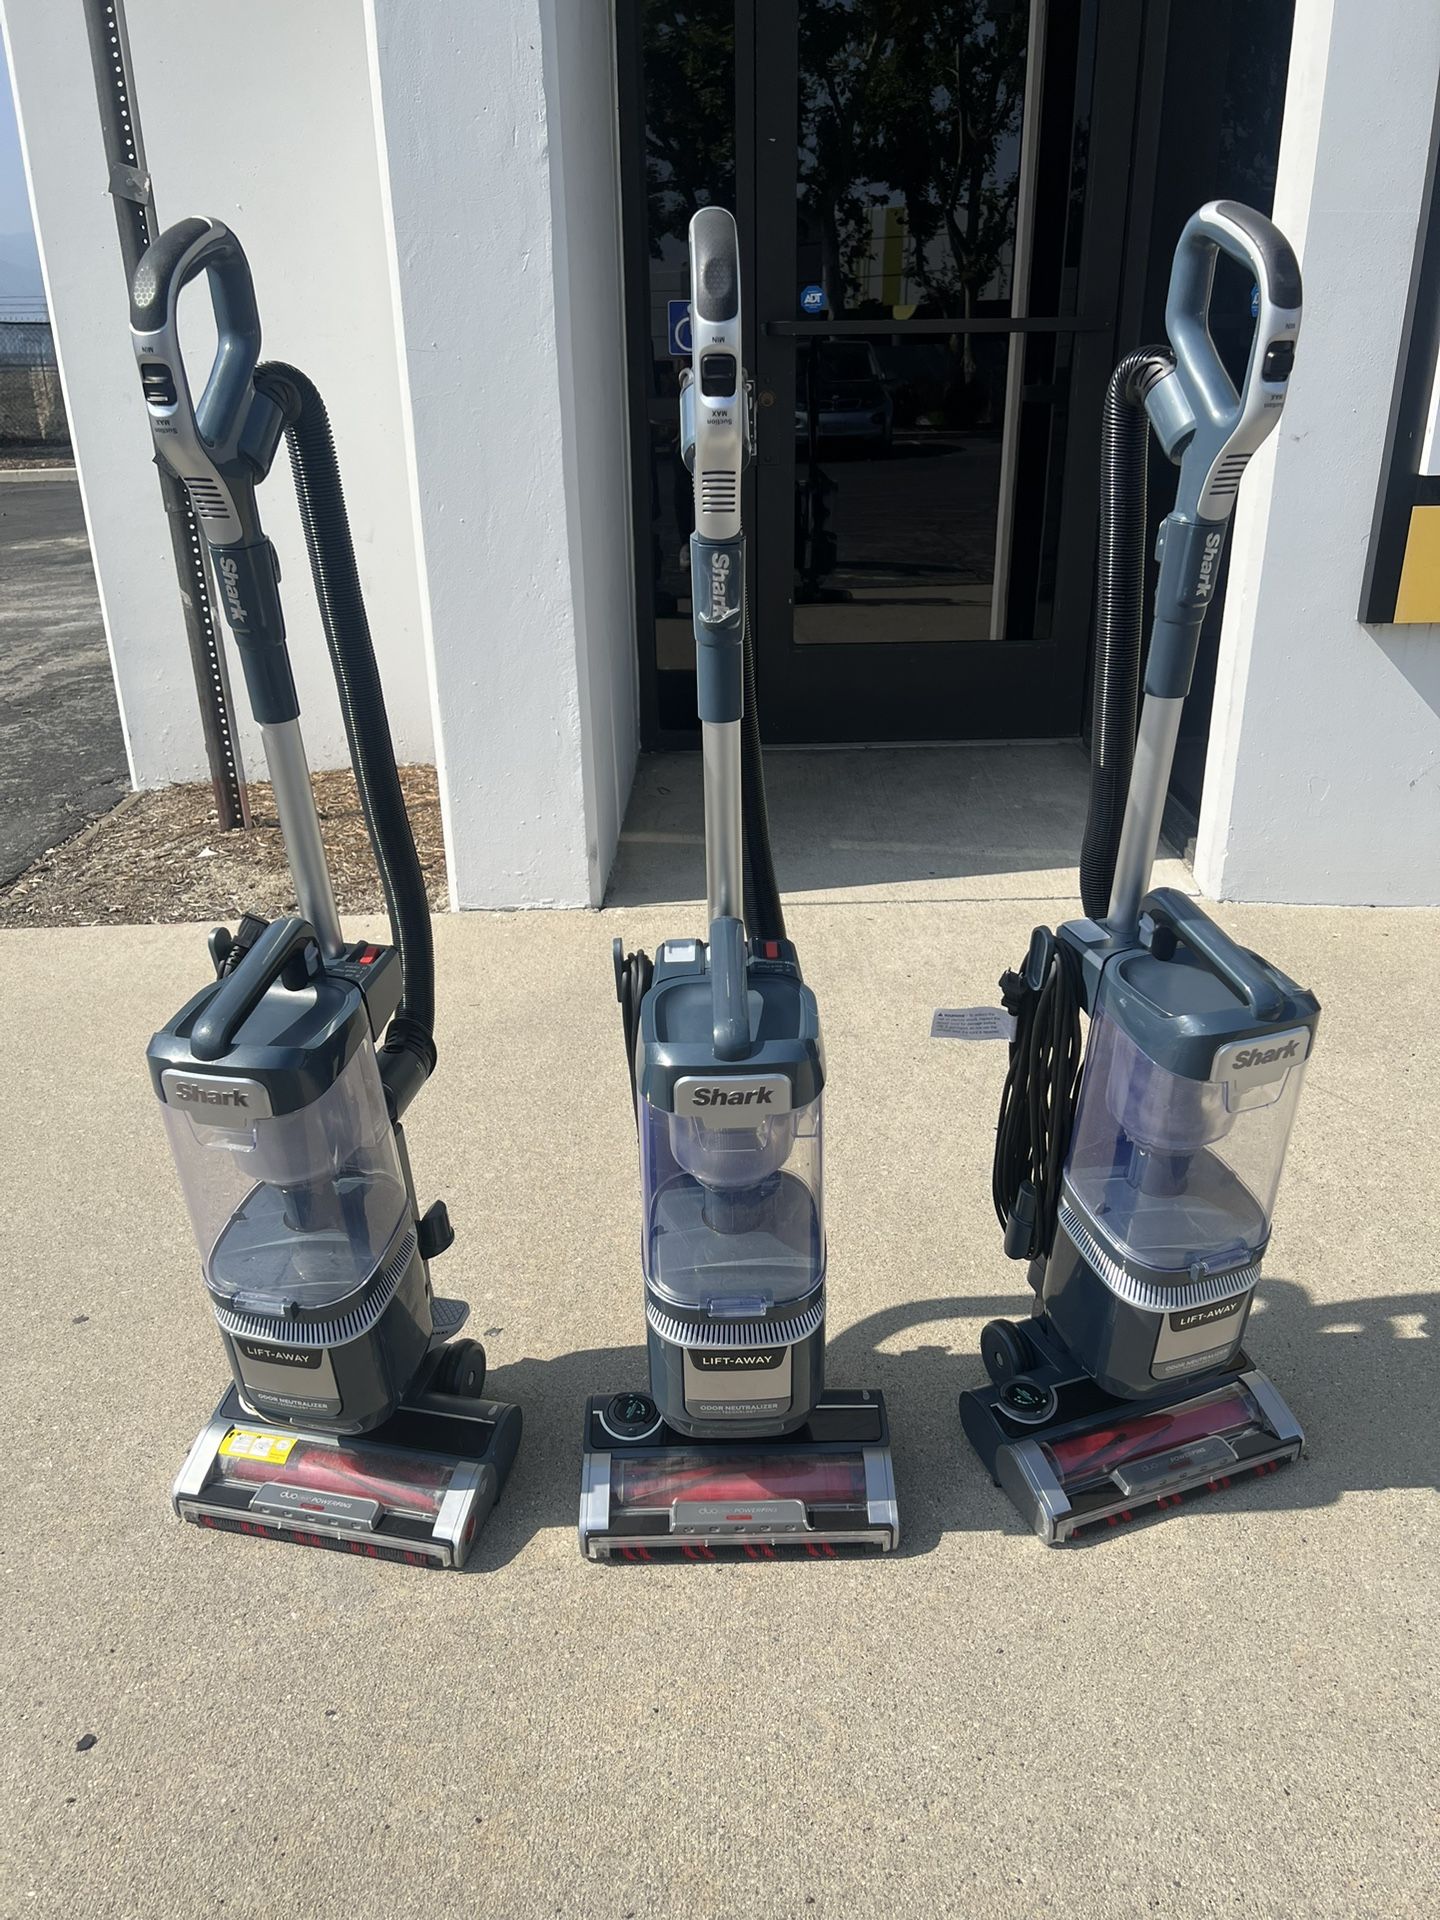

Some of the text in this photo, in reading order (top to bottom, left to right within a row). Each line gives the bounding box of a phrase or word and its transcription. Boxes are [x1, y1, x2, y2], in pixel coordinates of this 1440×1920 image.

[804, 292, 823, 304] ADT
[141, 345, 154, 353] MIN
[1195, 532, 1221, 597] Shark
[220, 556, 248, 623] Shark
[711, 552, 730, 618] Shark
[1232, 1040, 1300, 1070] Shark
[176, 1081, 249, 1107] Shark
[692, 1085, 774, 1106] Shark
[1180, 1302, 1238, 1326] LIFT-AWAY
[246, 1346, 310, 1363] LIFT-AWAY
[702, 1355, 773, 1365] LIFT-AWAY
[258, 1393, 328, 1409] ODOR NEUTRALIZER
[725, 1403, 778, 1411] NEUTRALIZER
[280, 1491, 298, 1500] duo
